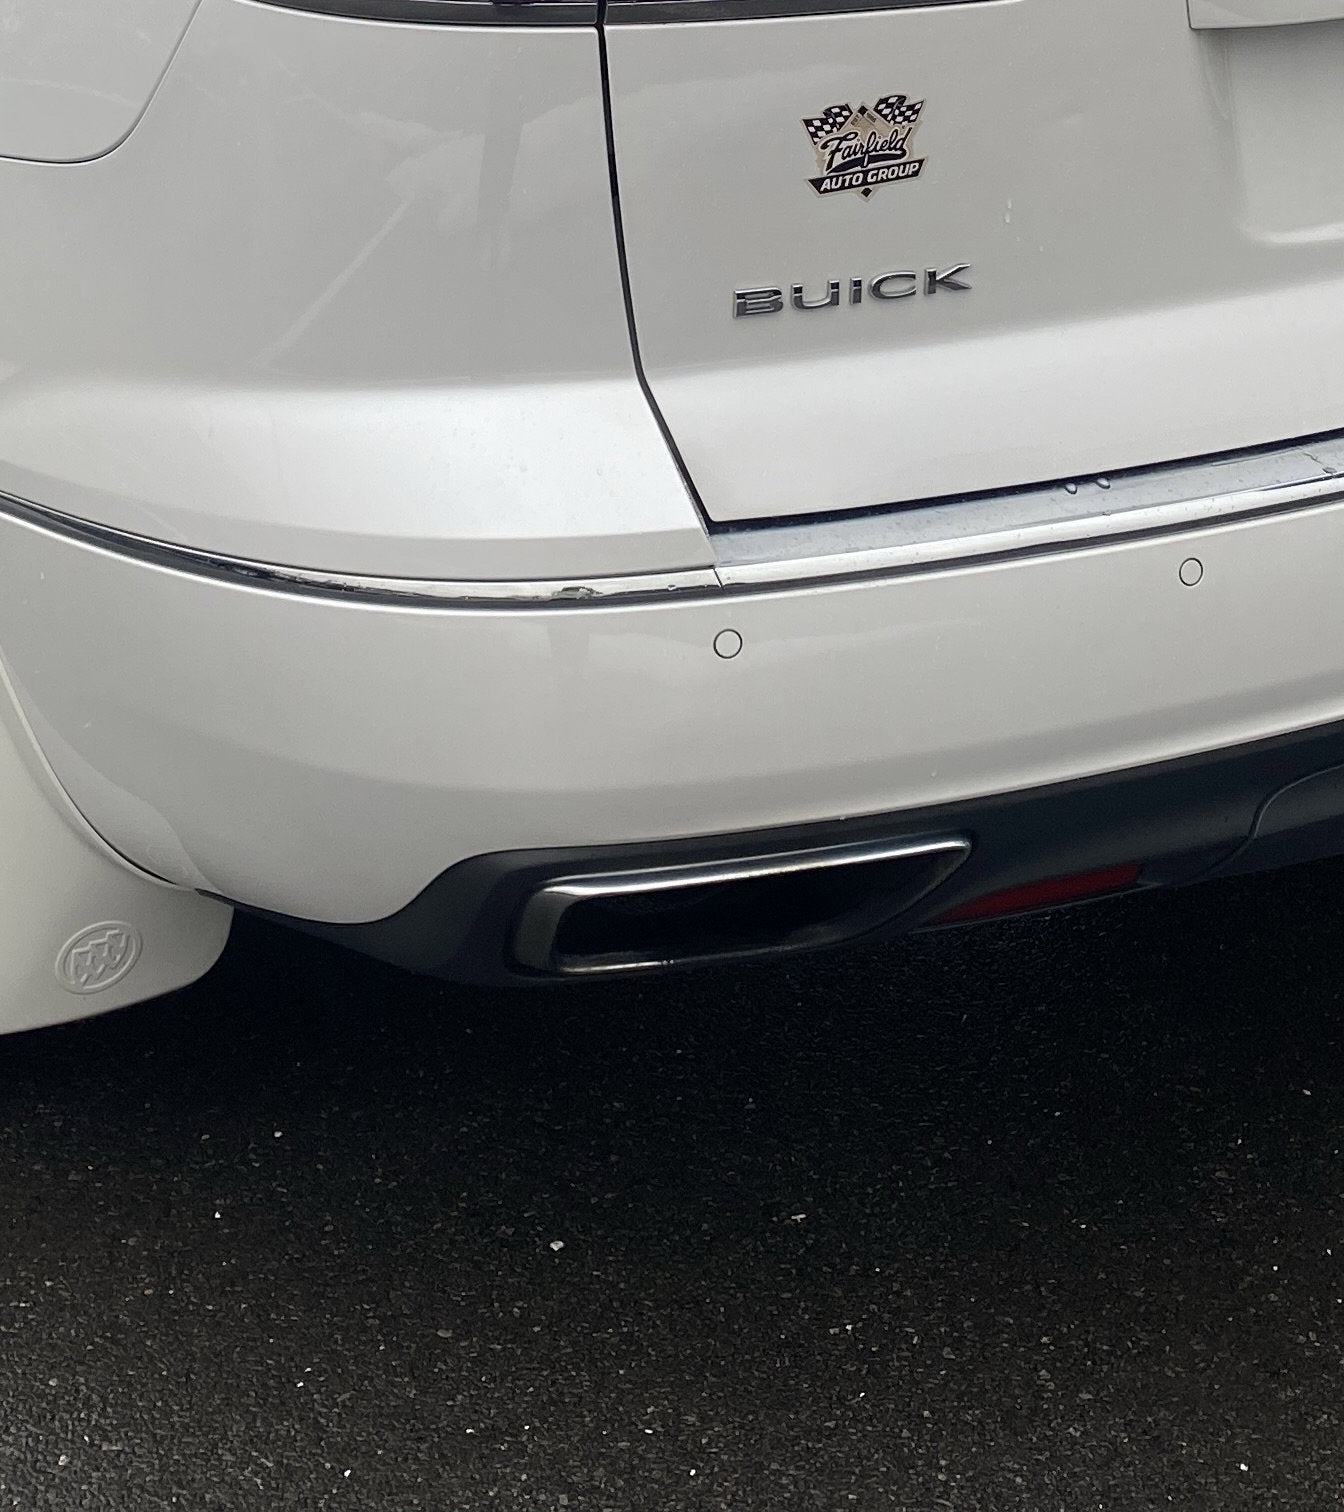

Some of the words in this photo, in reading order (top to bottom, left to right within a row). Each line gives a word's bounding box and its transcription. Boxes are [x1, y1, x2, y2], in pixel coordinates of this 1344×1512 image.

[820, 127, 912, 172] Fairfield
[820, 172, 863, 192] AUTO
[867, 162, 920, 183] GROUP
[733, 262, 972, 318] BUICK
